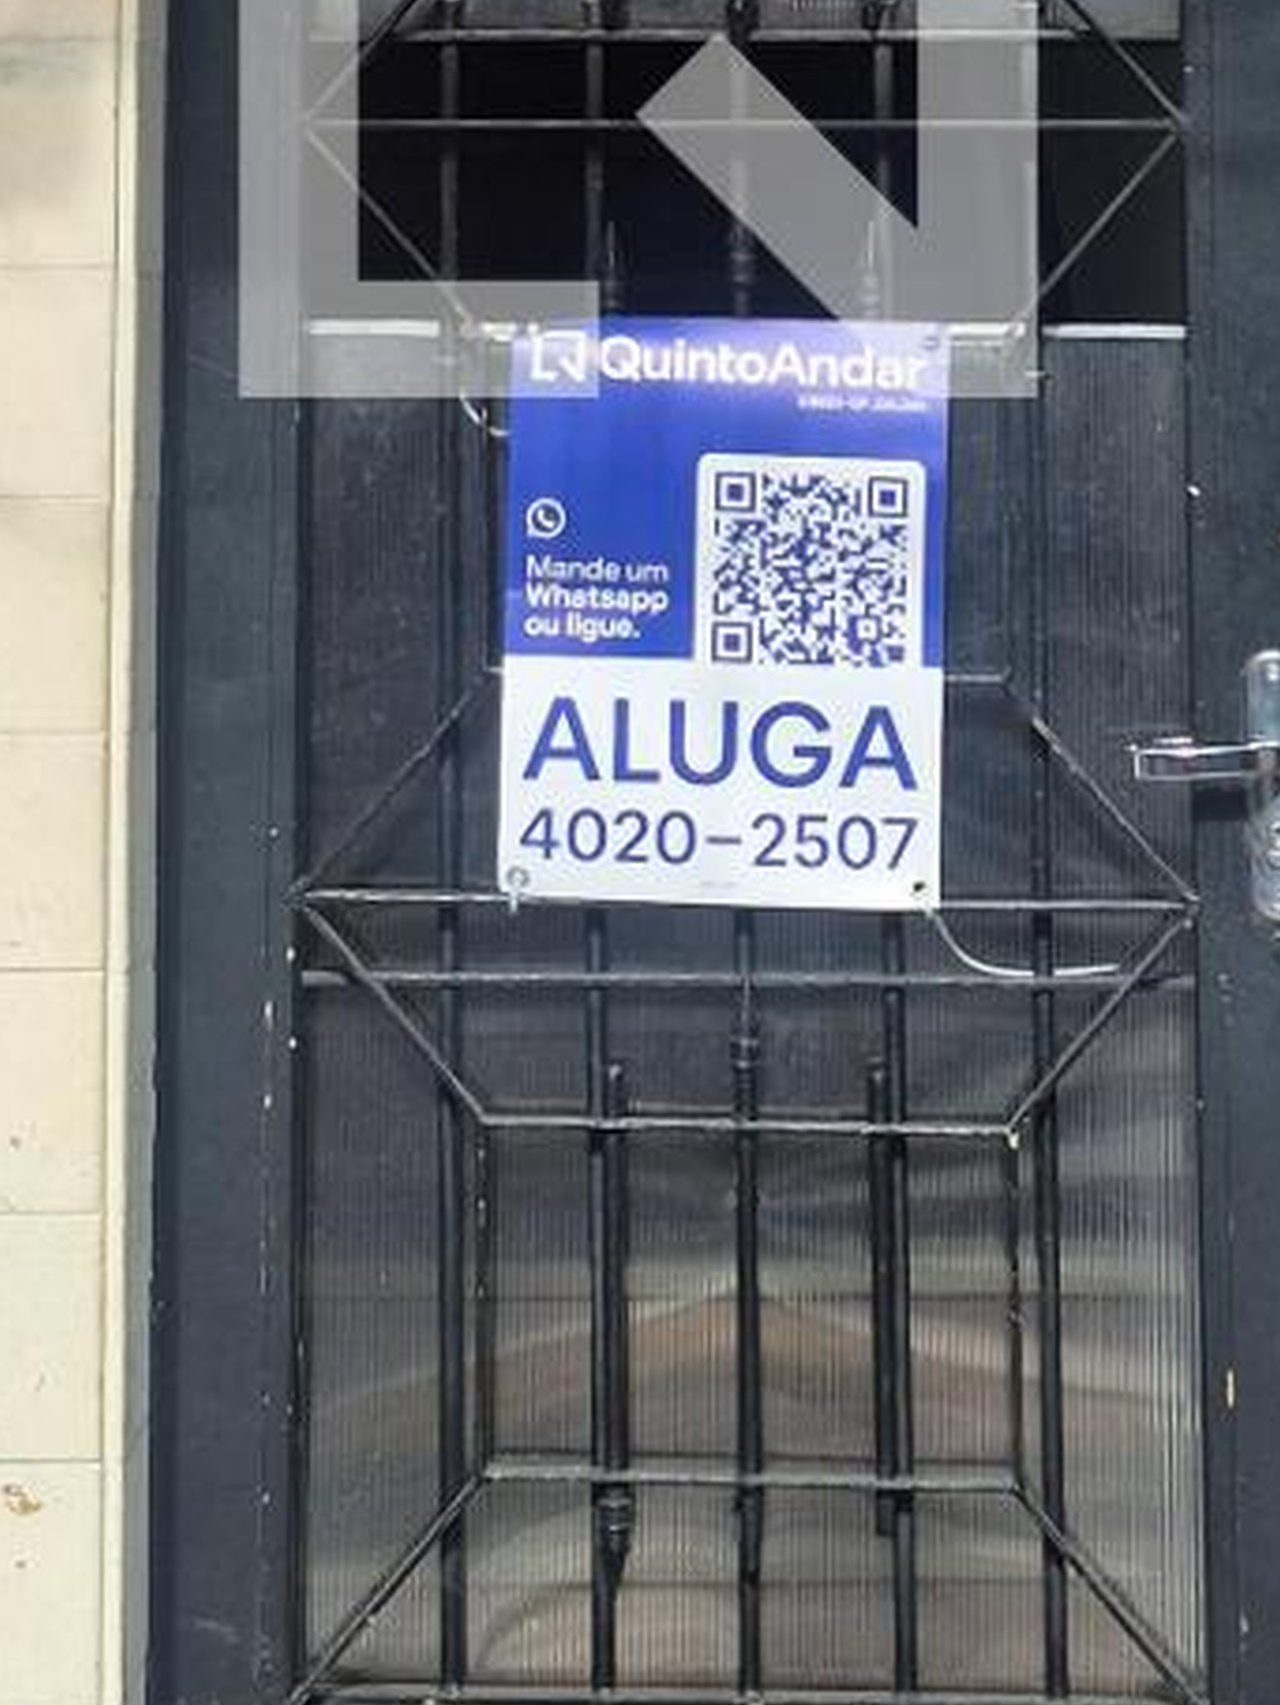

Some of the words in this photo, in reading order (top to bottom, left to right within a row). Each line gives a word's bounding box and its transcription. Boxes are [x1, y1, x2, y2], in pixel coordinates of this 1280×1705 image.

[600, 335, 927, 388] QuintoAndar
[525, 554, 619, 582] Mande
[625, 561, 669, 583] um
[525, 582, 670, 617] Whatsapp
[523, 615, 561, 637] ou
[565, 610, 642, 643] ligue.
[522, 696, 918, 791] ALUGA
[519, 807, 920, 871] 4020-2507
